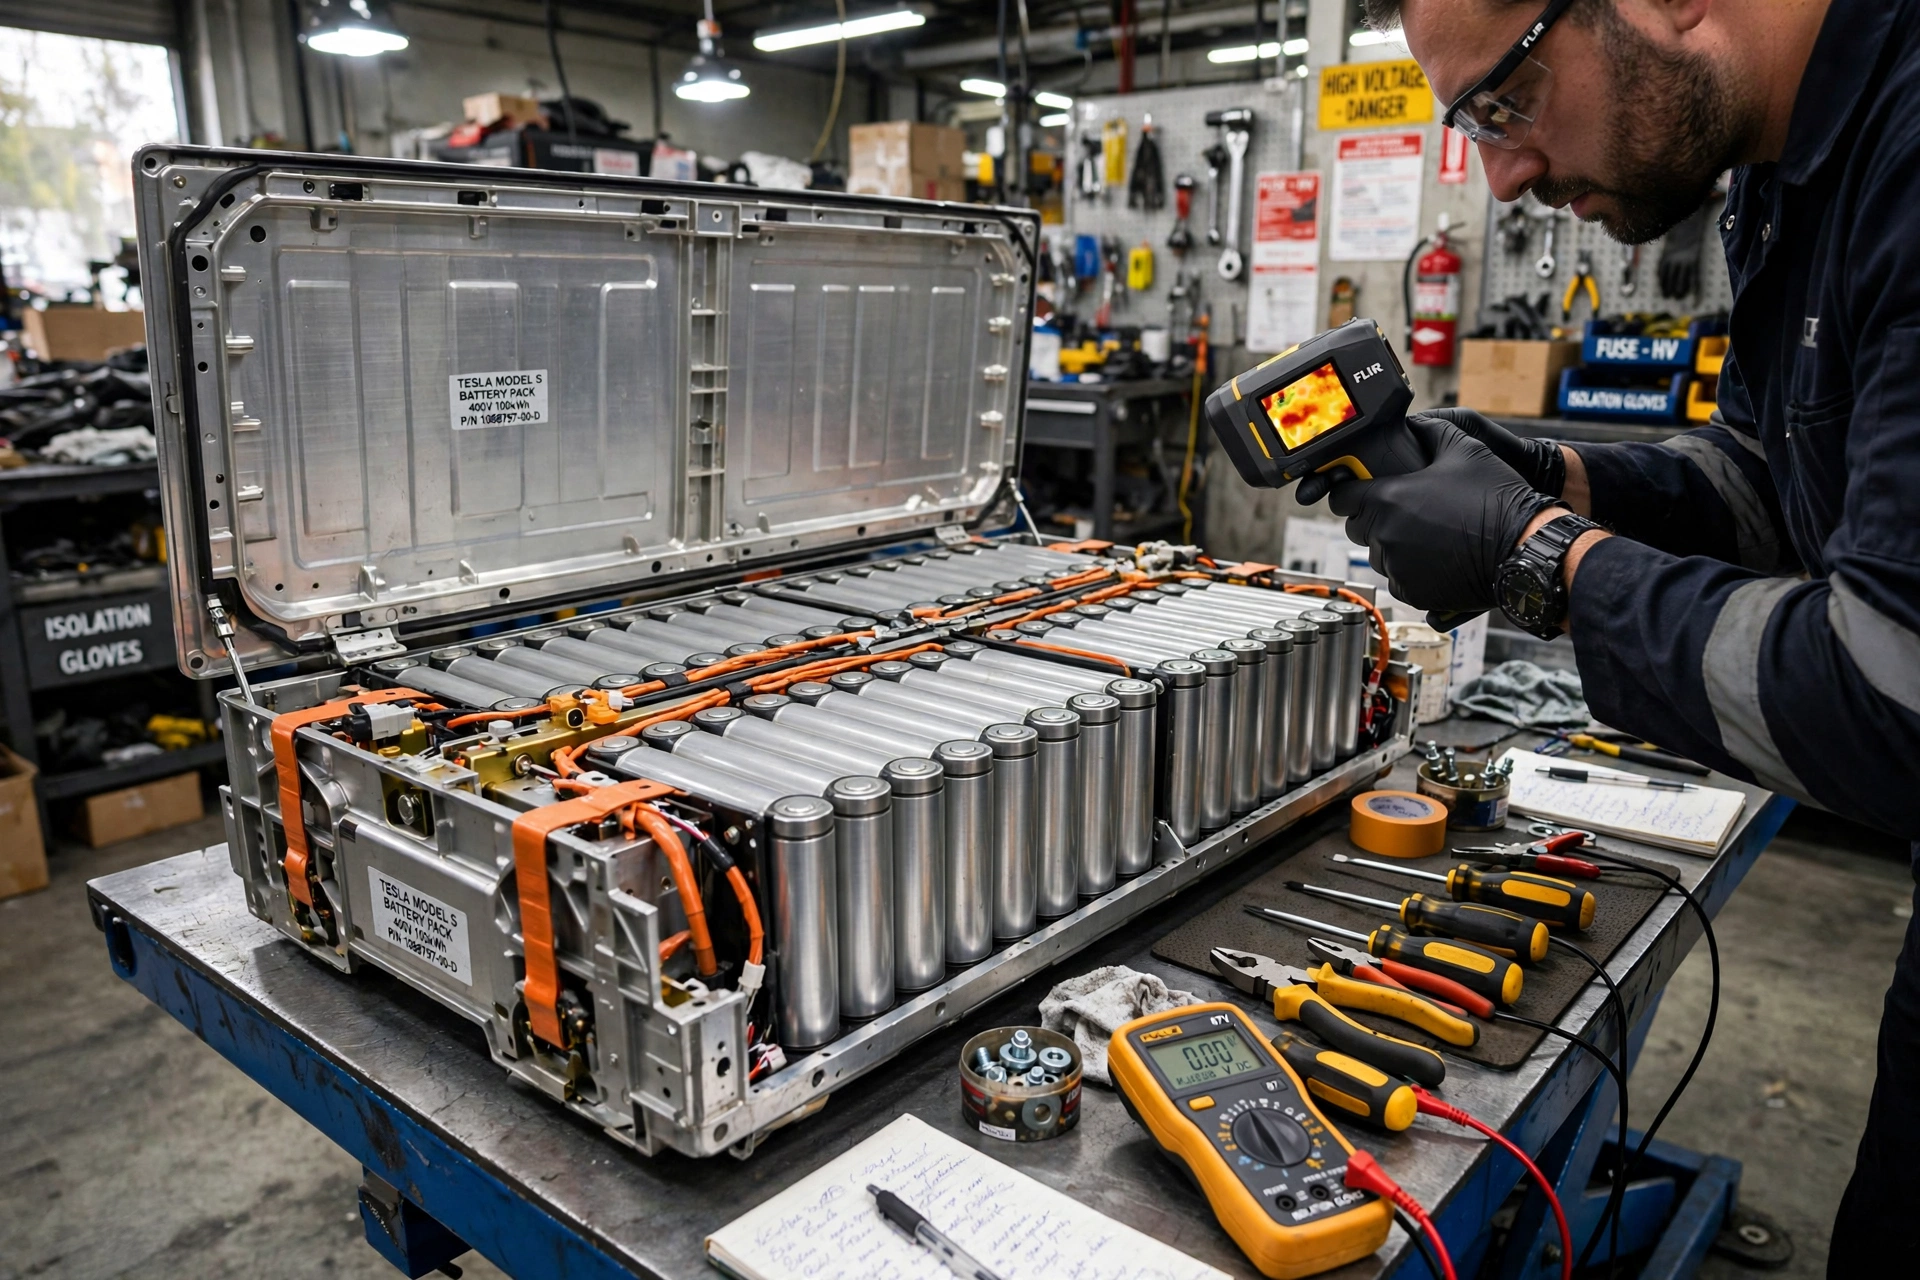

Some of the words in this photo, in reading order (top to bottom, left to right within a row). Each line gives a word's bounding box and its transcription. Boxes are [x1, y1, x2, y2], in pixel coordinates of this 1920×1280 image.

[1325, 70, 1357, 95] HIGH
[1346, 95, 1407, 121] DANGER
[1595, 338, 1639, 360] FUSE
[1651, 338, 1680, 360] HV
[457, 377, 493, 389] TESLA
[495, 375, 532, 386] MODEL
[536, 374, 543, 384] S
[1353, 362, 1384, 384] FLIR
[459, 389, 507, 401] BATTERY
[510, 387, 536, 399] PACK
[469, 402, 493, 412] 400V
[460, 416, 478, 426] P/N
[44, 602, 152, 641] ISOLATION
[59, 639, 143, 675] GLOVES
[379, 878, 410, 904] TESLA
[412, 895, 448, 923] MODEL
[450, 913, 458, 928] S
[383, 897, 425, 927] BATTERY
[427, 918, 453, 942] PACK
[1182, 1040, 1233, 1071] 0.00
[1221, 1065, 1231, 1075] V
[1236, 1060, 1252, 1072] DC
